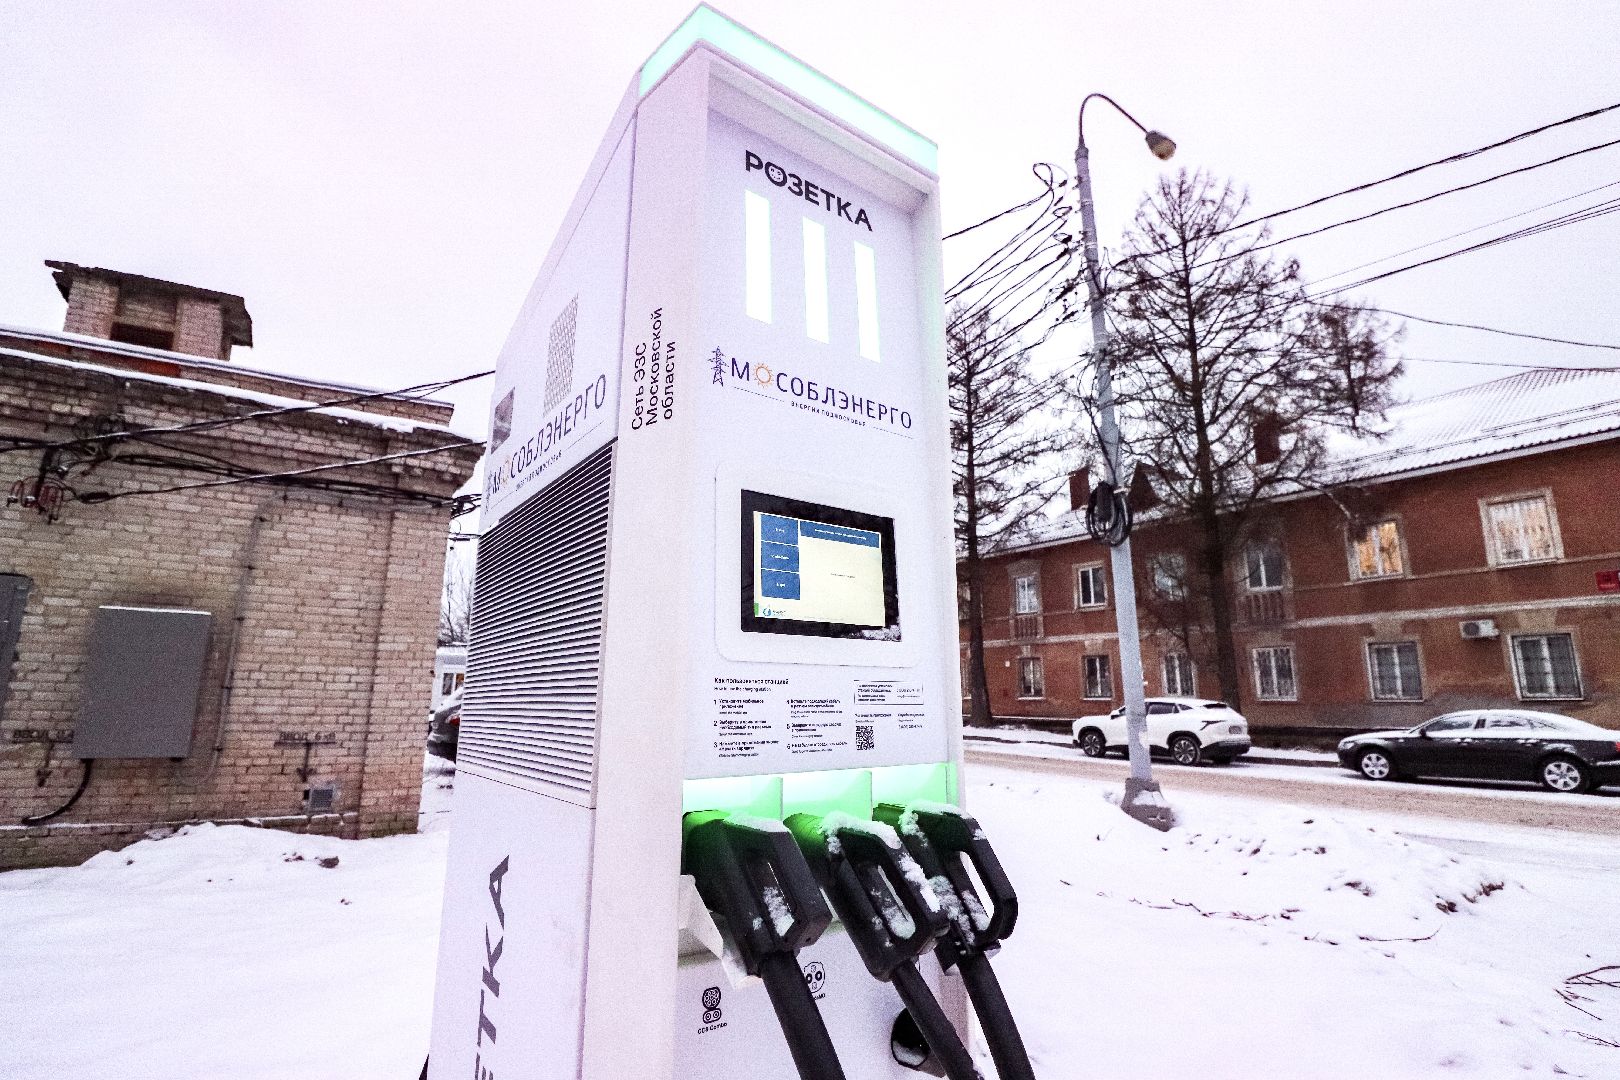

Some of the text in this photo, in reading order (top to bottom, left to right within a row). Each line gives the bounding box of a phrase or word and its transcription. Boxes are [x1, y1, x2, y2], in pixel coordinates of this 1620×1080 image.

[745, 149, 873, 232] РОЗЕТКА
[631, 342, 647, 430] Сеть ЭЗС
[645, 307, 663, 426] Московской
[661, 341, 676, 420] области
[731, 357, 913, 430] МОСОБЛЭНЕРГО
[492, 373, 607, 494] МОСОБЛЭНЕРГО
